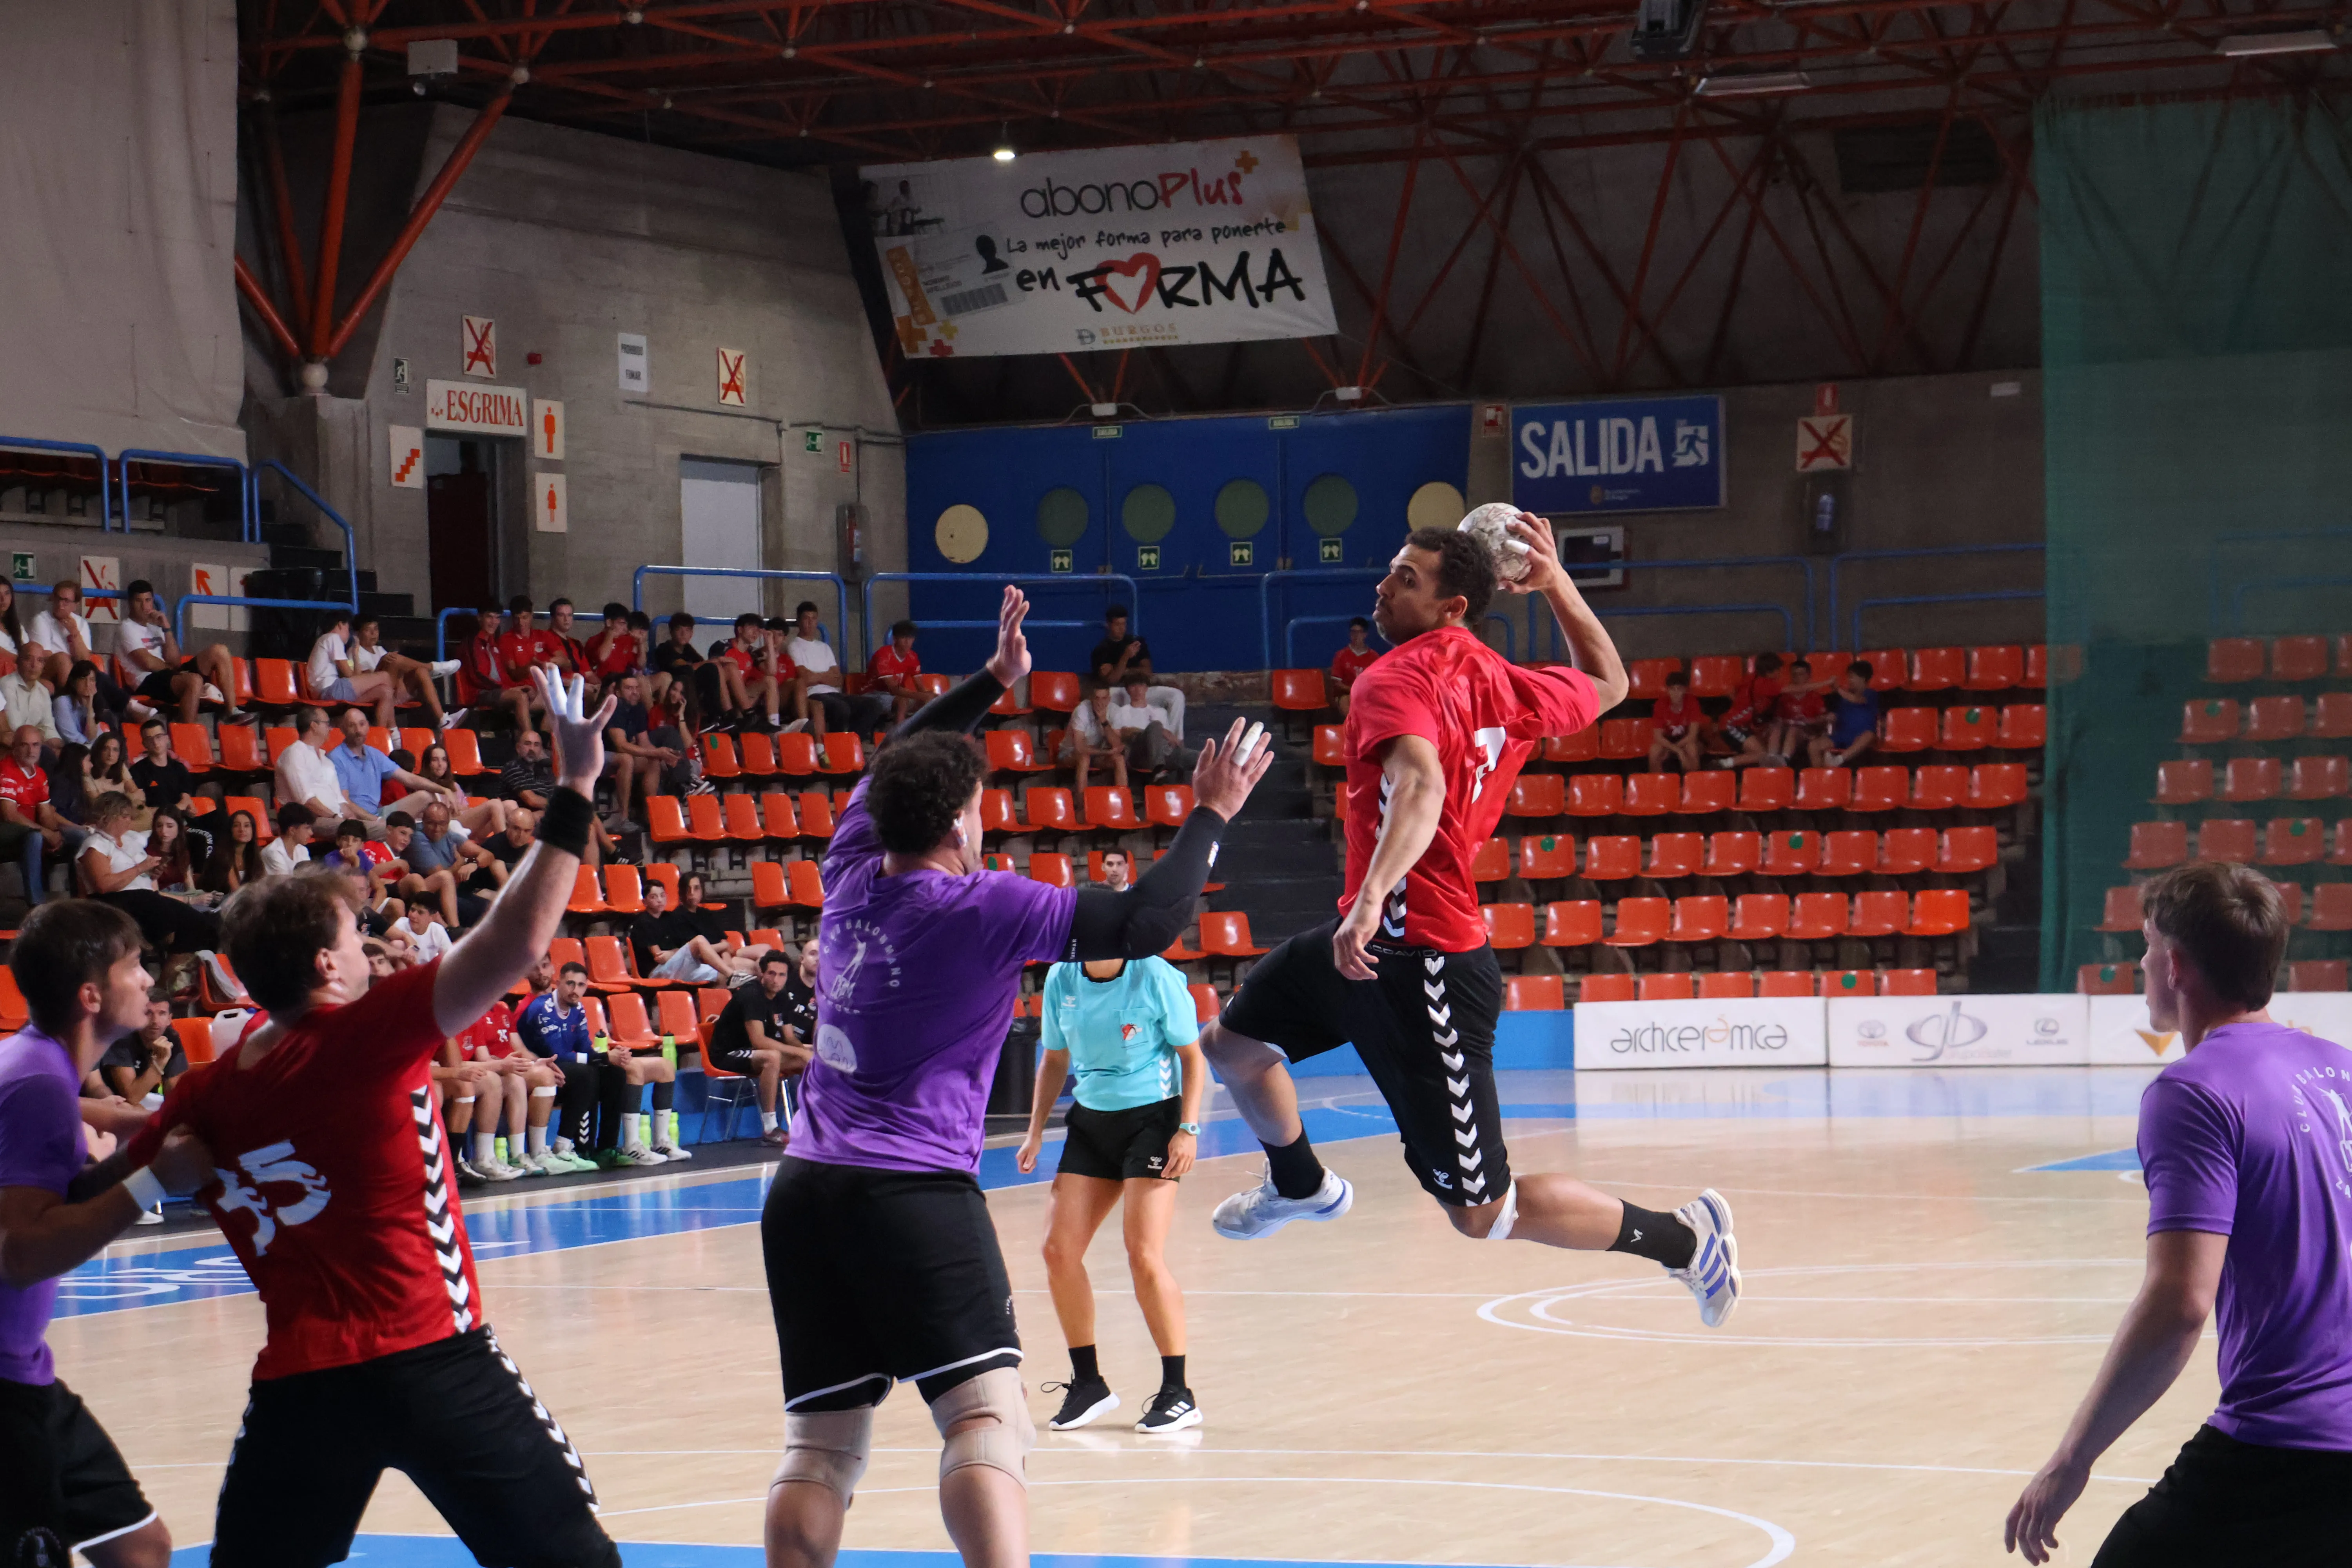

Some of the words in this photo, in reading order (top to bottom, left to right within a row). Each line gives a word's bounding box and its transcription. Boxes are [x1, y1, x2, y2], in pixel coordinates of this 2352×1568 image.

[1007, 238, 1027, 254] La
[1036, 235, 1086, 260] mejor
[1096, 231, 1150, 248] forma
[1161, 230, 1203, 246] para
[1212, 220, 1286, 243] ponerte
[1016, 268, 1060, 292] en
[447, 390, 524, 426] ESGRIMA
[1521, 416, 1664, 479] SALIDA
